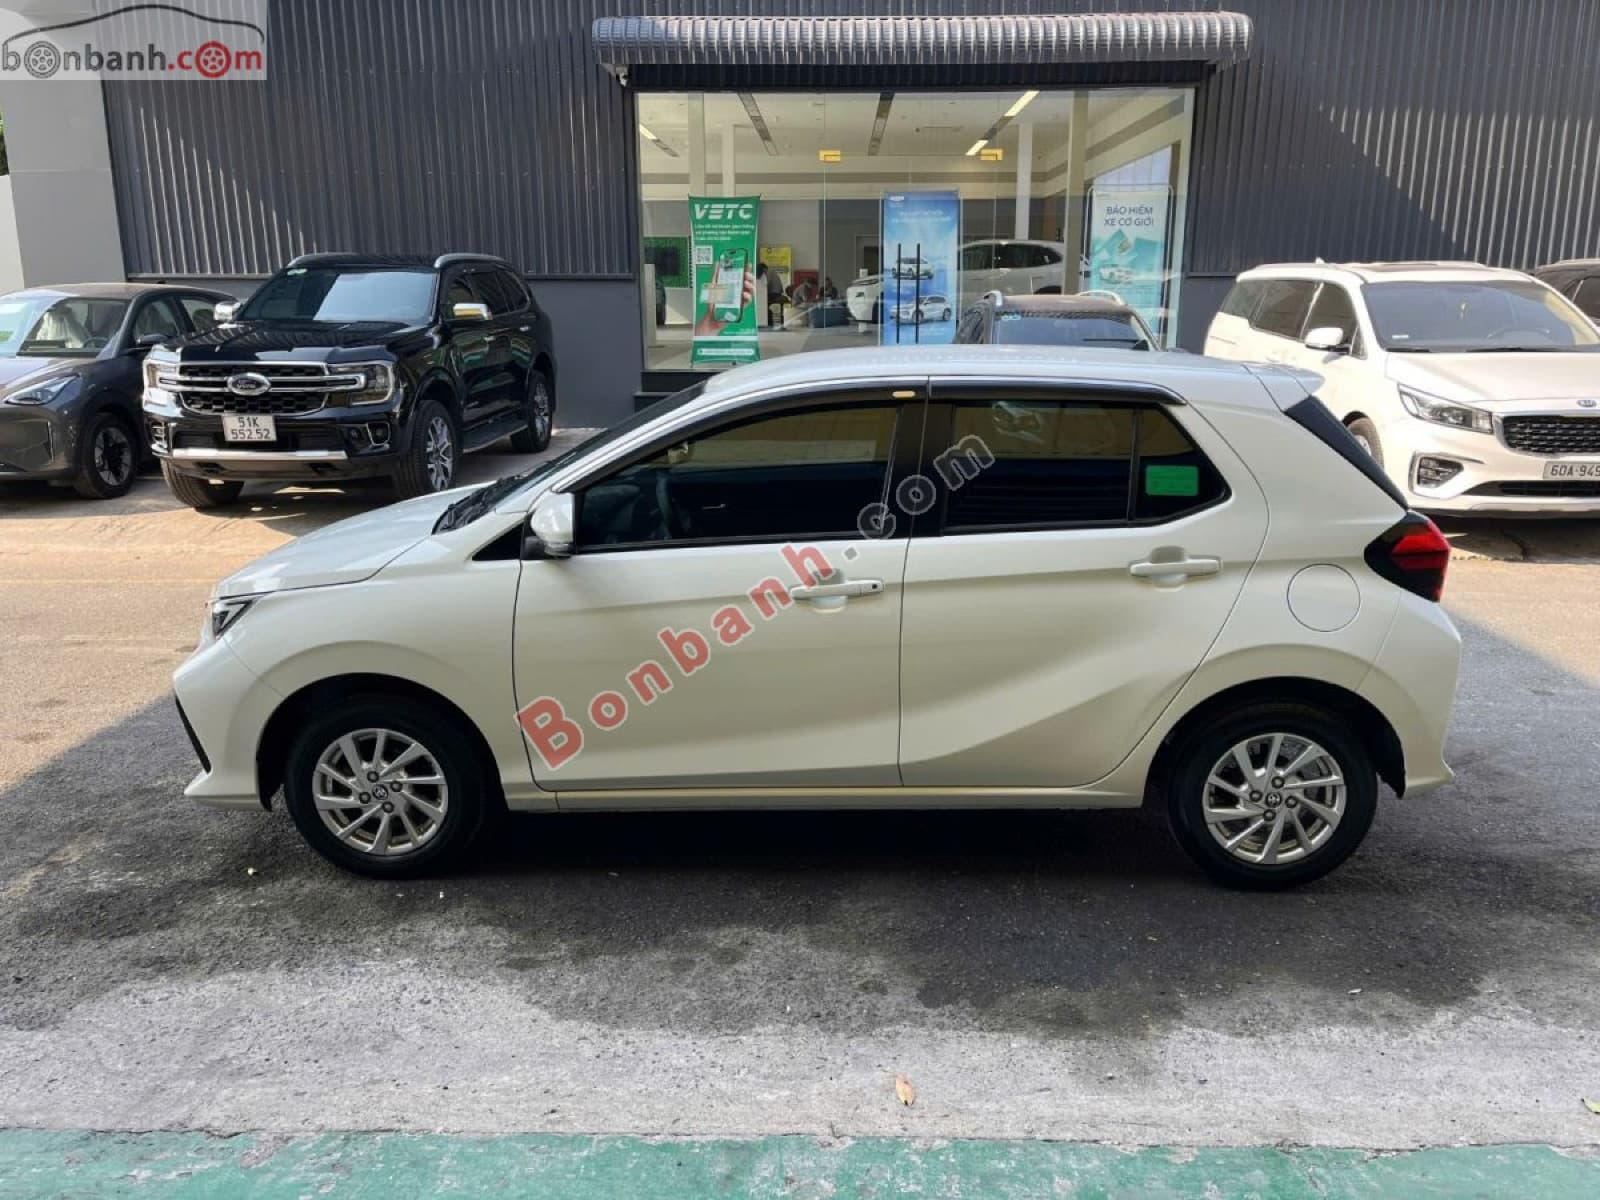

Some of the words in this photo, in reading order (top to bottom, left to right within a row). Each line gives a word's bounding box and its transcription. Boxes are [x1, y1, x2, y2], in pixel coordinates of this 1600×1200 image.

[694, 203, 753, 220] VETC
[1104, 218, 1117, 226] XE
[238, 416, 260, 428] 51K
[231, 428, 271, 440] 552.52
